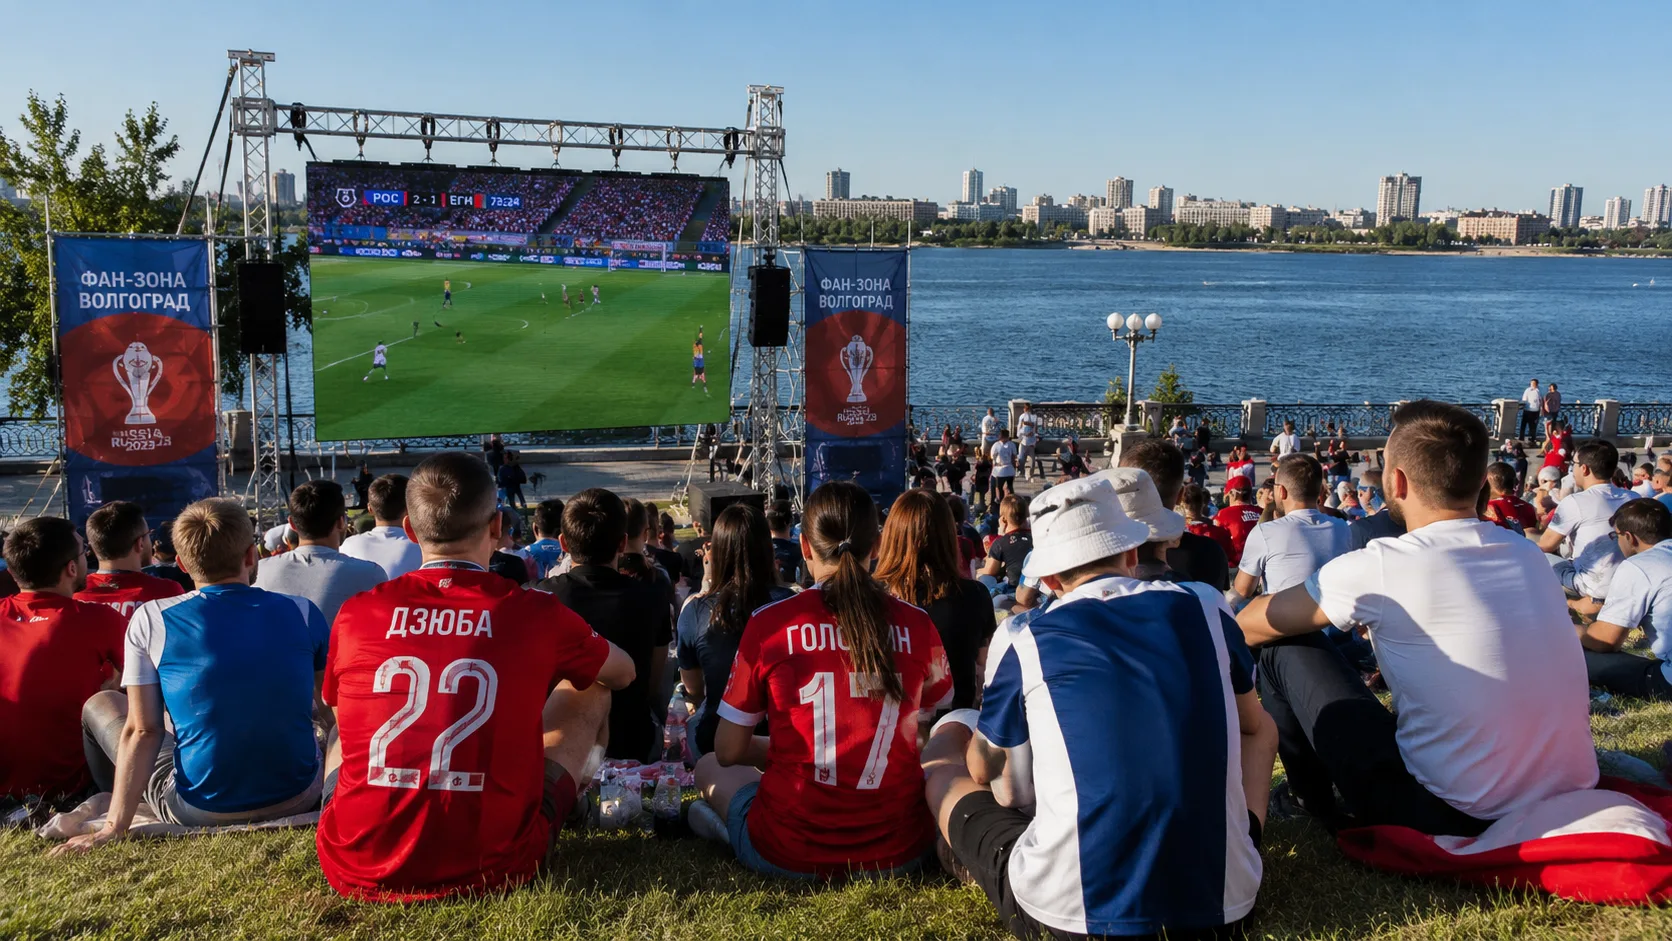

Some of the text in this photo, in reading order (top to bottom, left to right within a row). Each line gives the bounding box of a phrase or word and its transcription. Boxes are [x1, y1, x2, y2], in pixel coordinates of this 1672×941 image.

[373, 193, 400, 204] РОС
[80, 271, 187, 288] ФАН-ЗОНА
[821, 277, 891, 291] ФАН-ЗОНА
[78, 292, 191, 312] ВОЛГОГРАД
[819, 295, 894, 310] ВОЛГОГРАД
[385, 607, 492, 639] ДЗЮБА
[367, 656, 498, 791] 22
[799, 672, 902, 789] 17
